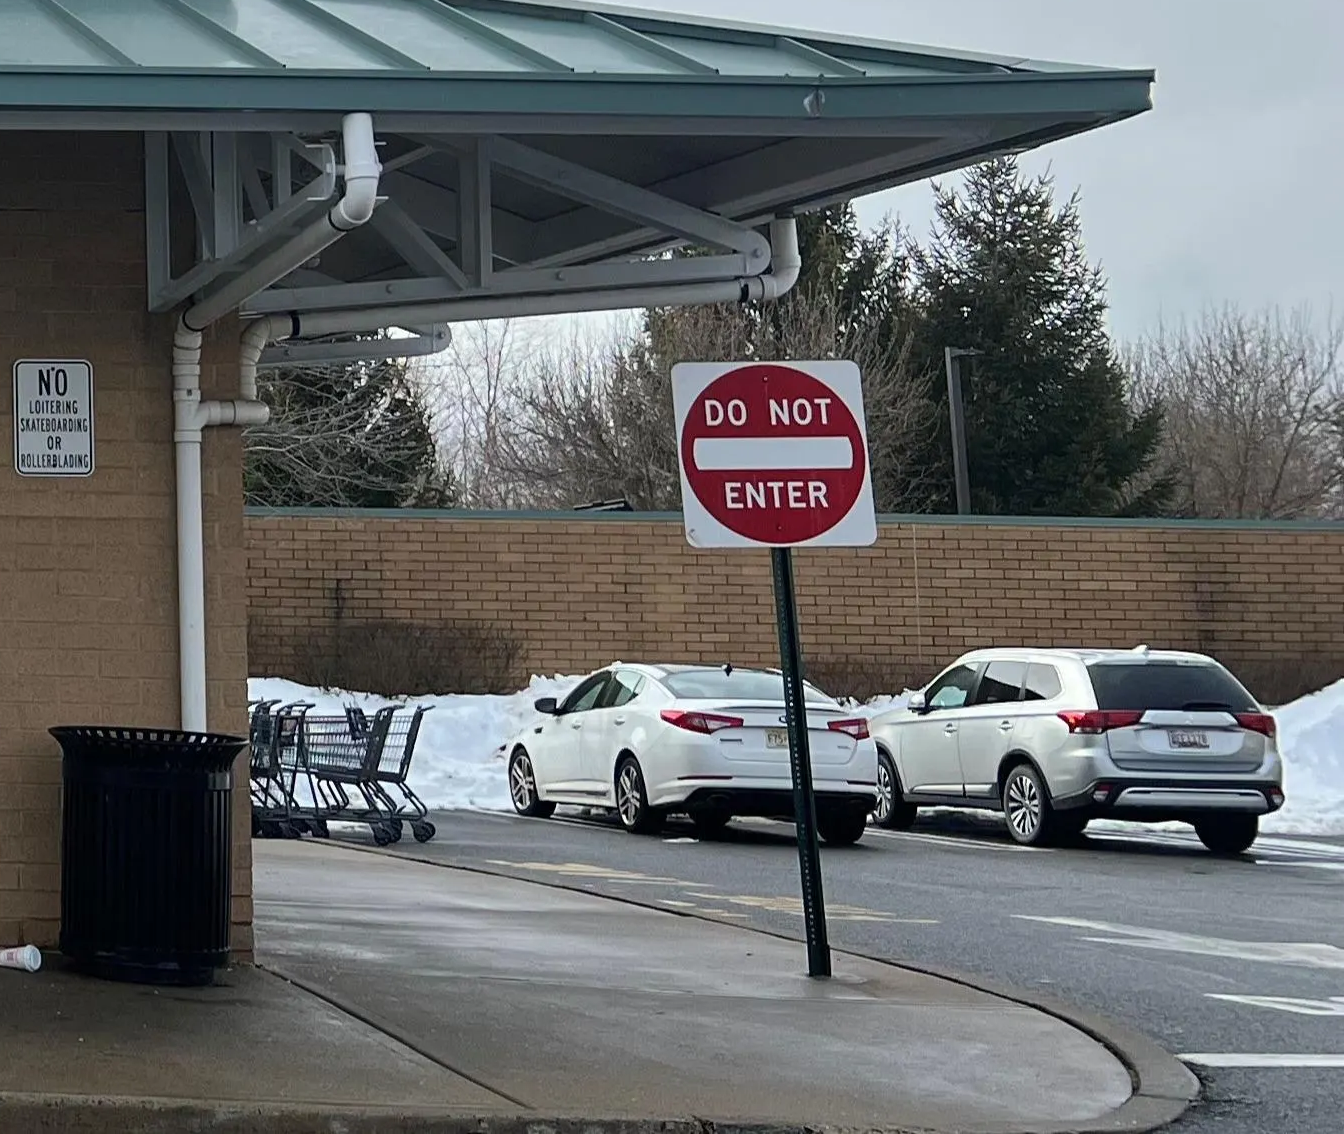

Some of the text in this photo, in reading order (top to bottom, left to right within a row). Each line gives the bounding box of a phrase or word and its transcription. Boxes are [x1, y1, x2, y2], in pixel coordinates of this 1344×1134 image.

[38, 369, 68, 396] NO
[29, 400, 78, 414] LOITERING
[704, 398, 831, 426] DO NOT
[20, 418, 88, 433] SKATEBOARDING
[47, 435, 62, 450] OR
[21, 454, 89, 468] ROLLERBLADING
[724, 481, 829, 509] ENTER
